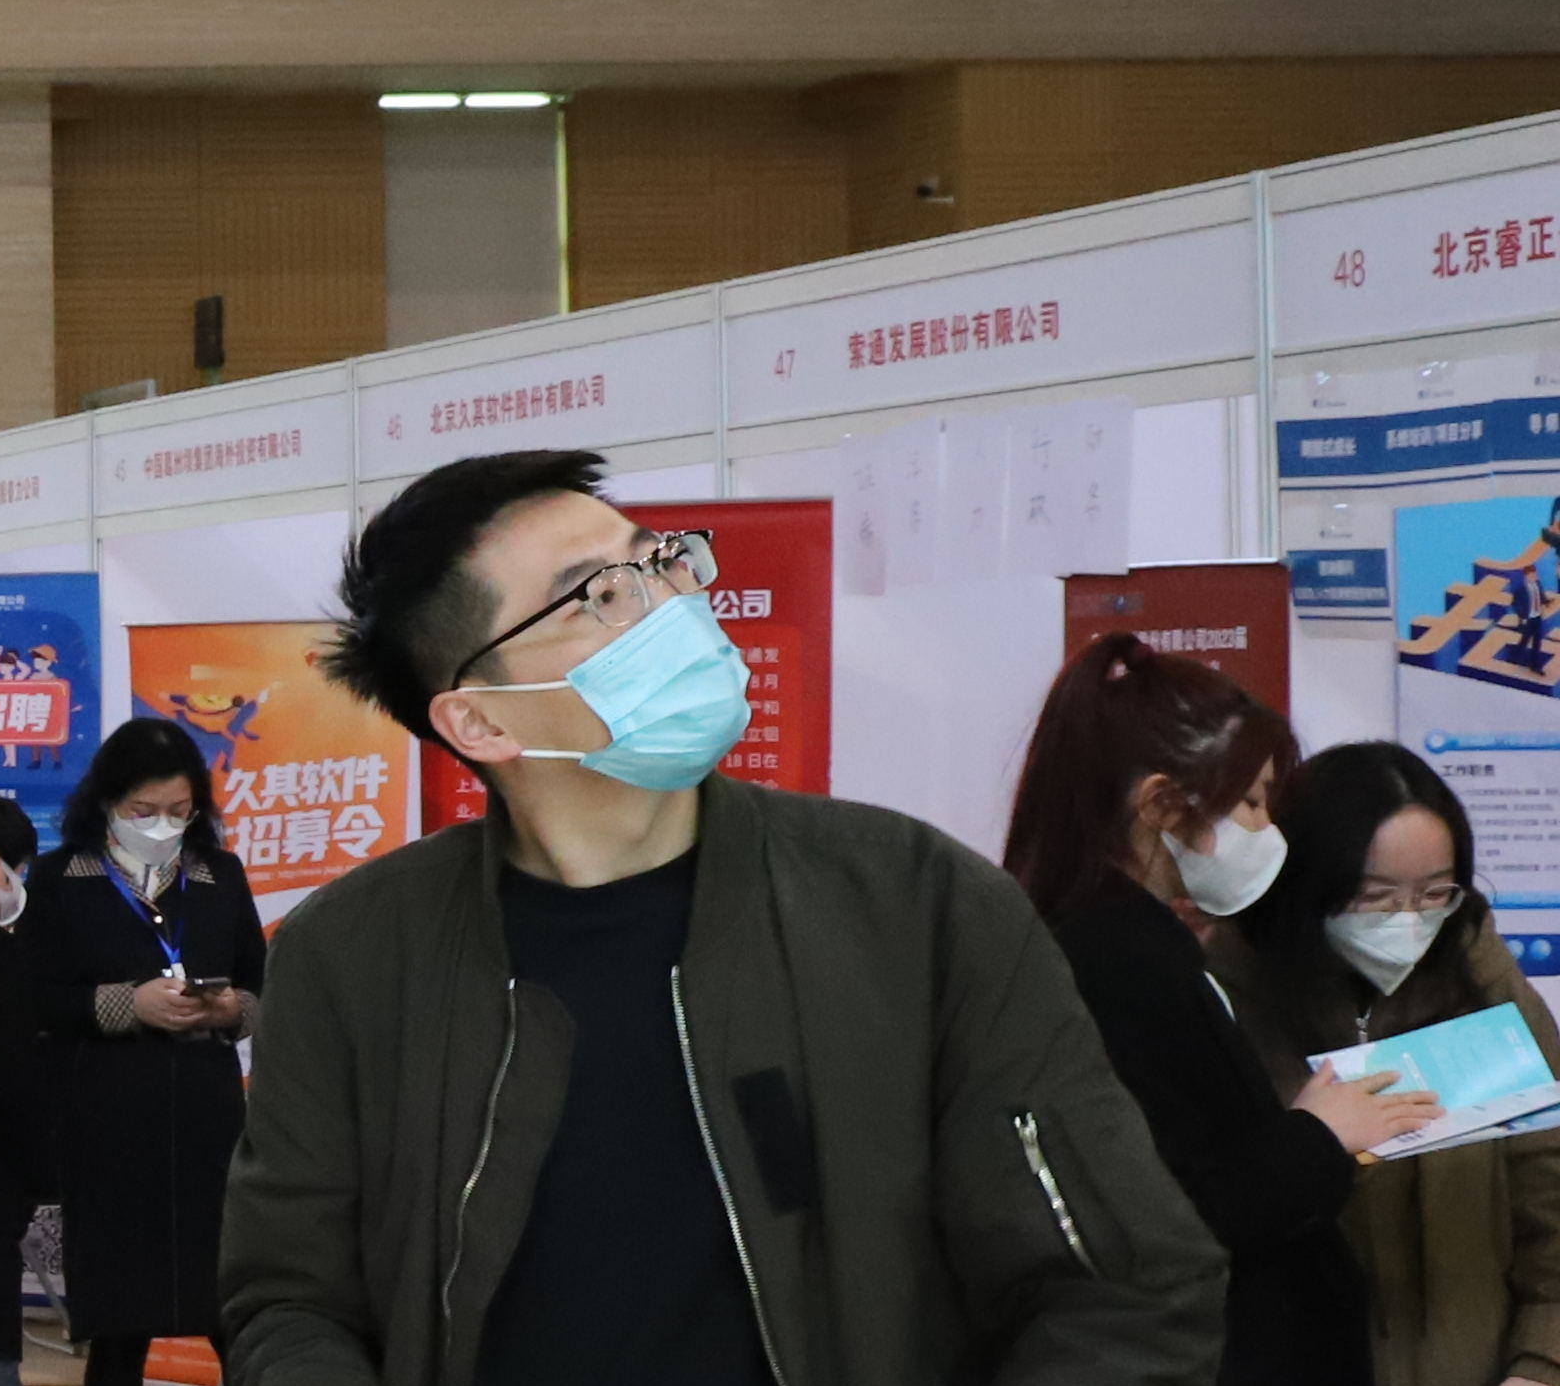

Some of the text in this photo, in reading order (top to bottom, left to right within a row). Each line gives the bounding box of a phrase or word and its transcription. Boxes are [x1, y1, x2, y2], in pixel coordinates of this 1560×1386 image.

[1334, 215, 1560, 289] 48 北京睿正
[774, 301, 1061, 380] 47 索通发展股份有限公司
[430, 375, 607, 434] 北京久其软件股份有限公司
[712, 588, 773, 620] 公司
[743, 647, 780, 664] 通发
[223, 753, 390, 815] 久其软件
